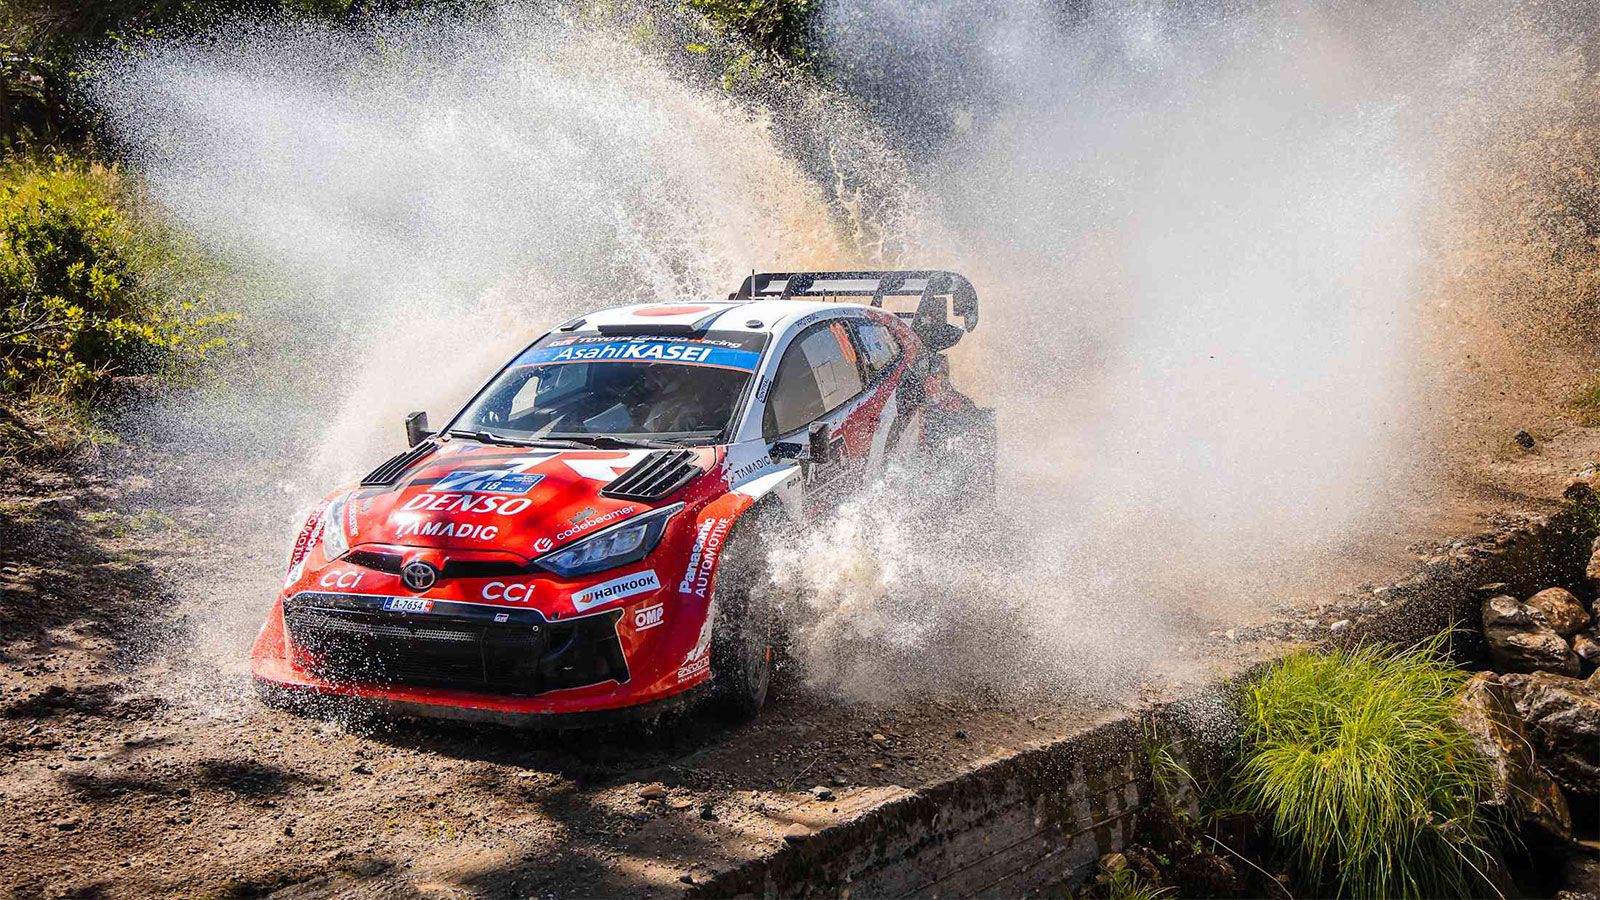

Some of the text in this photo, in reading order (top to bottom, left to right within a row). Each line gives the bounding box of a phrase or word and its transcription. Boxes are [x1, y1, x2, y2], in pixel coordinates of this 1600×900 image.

[735, 456, 771, 479] TAMADIC
[481, 481, 503, 490] 18
[400, 493, 533, 516] DENSO
[394, 521, 499, 541] TAMADIC
[556, 505, 636, 541] codebeamer
[679, 517, 716, 594] Panasonic
[695, 517, 730, 598] AUTOMOTIVE
[393, 600, 423, 611] A-7654
[635, 606, 664, 627] OMP
